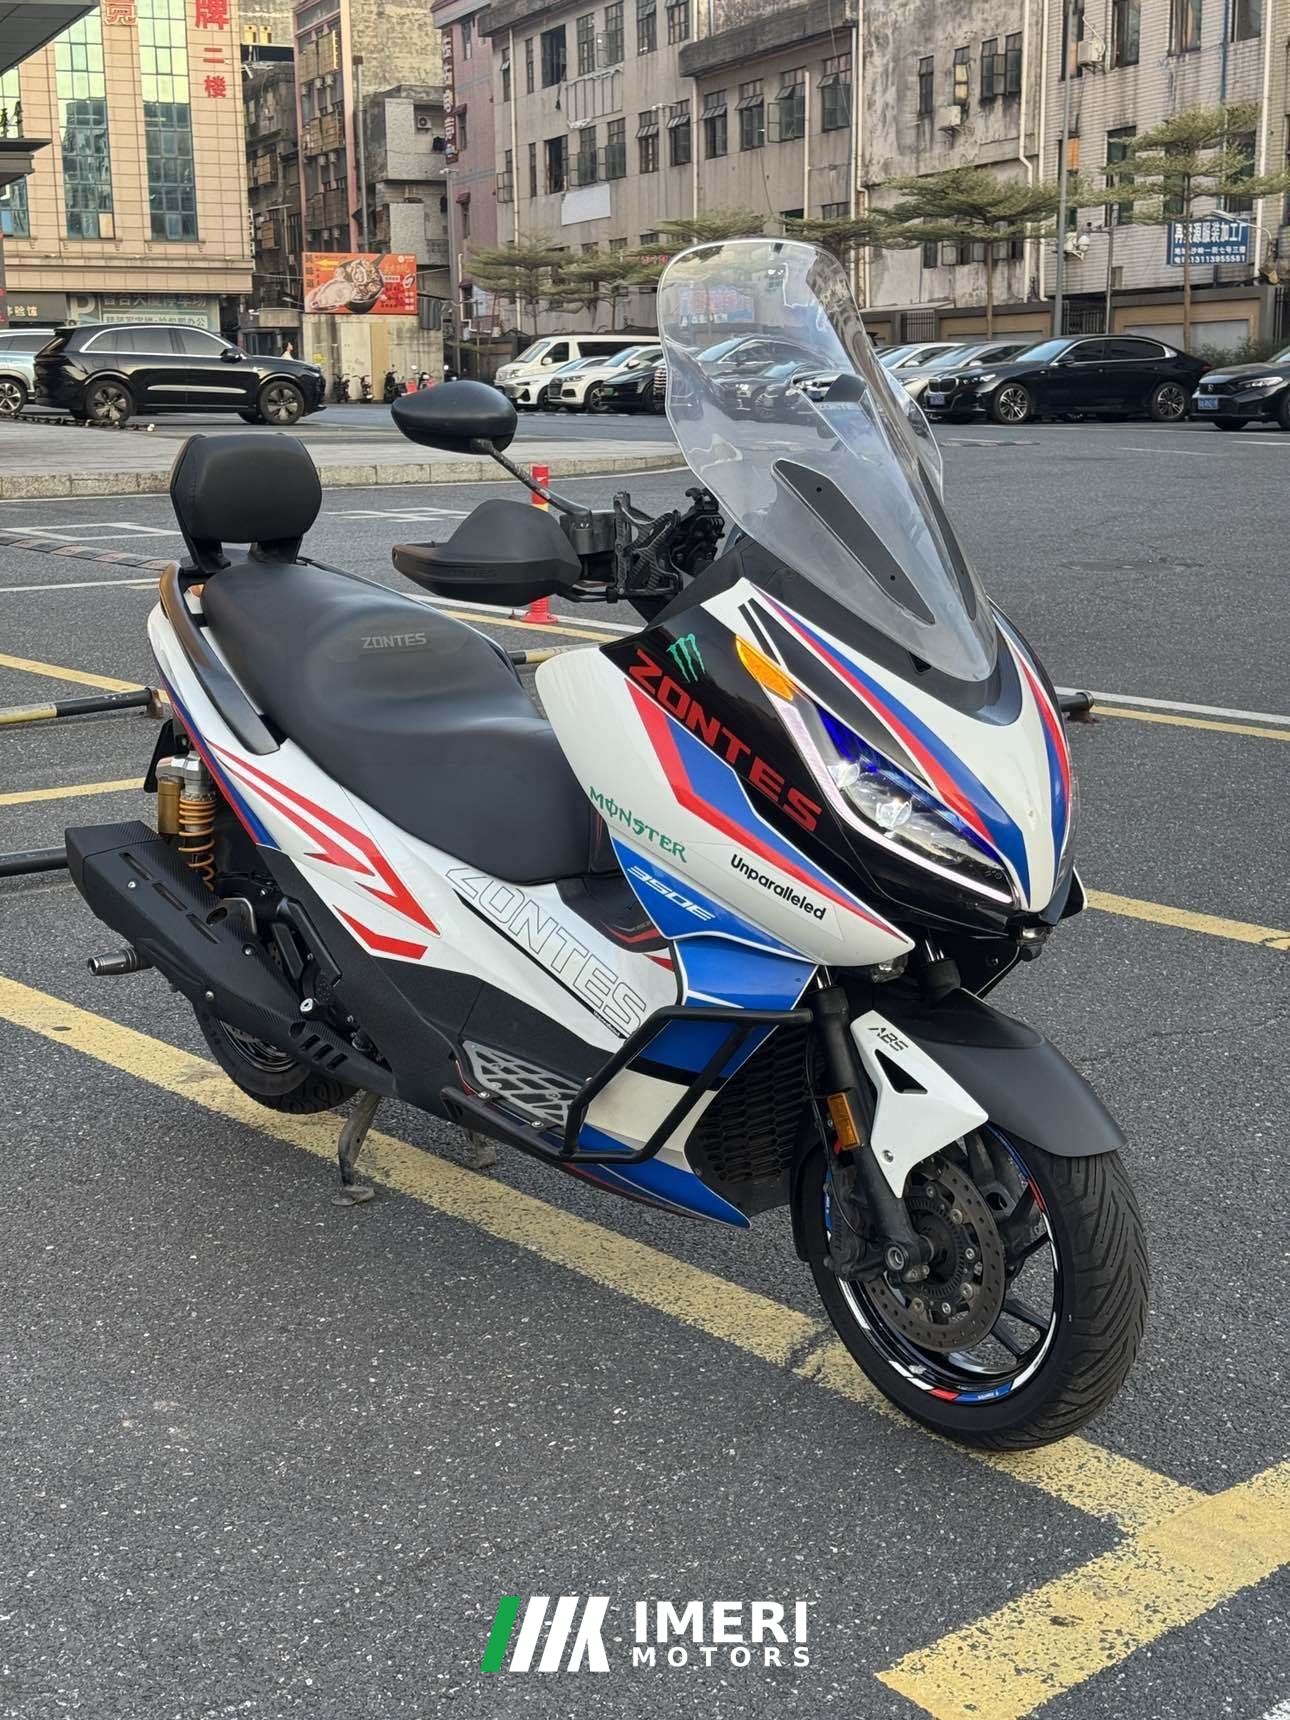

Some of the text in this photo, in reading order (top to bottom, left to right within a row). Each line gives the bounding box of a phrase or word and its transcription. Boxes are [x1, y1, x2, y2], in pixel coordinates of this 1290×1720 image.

[360, 632, 427, 649] ZONTES
[628, 648, 822, 832] ZONTES
[589, 785, 688, 864] MONSTER
[626, 865, 716, 922] 350E
[730, 853, 827, 922] Unparalleled
[445, 866, 648, 1038] ZONTES
[868, 1027, 910, 1052] ABS
